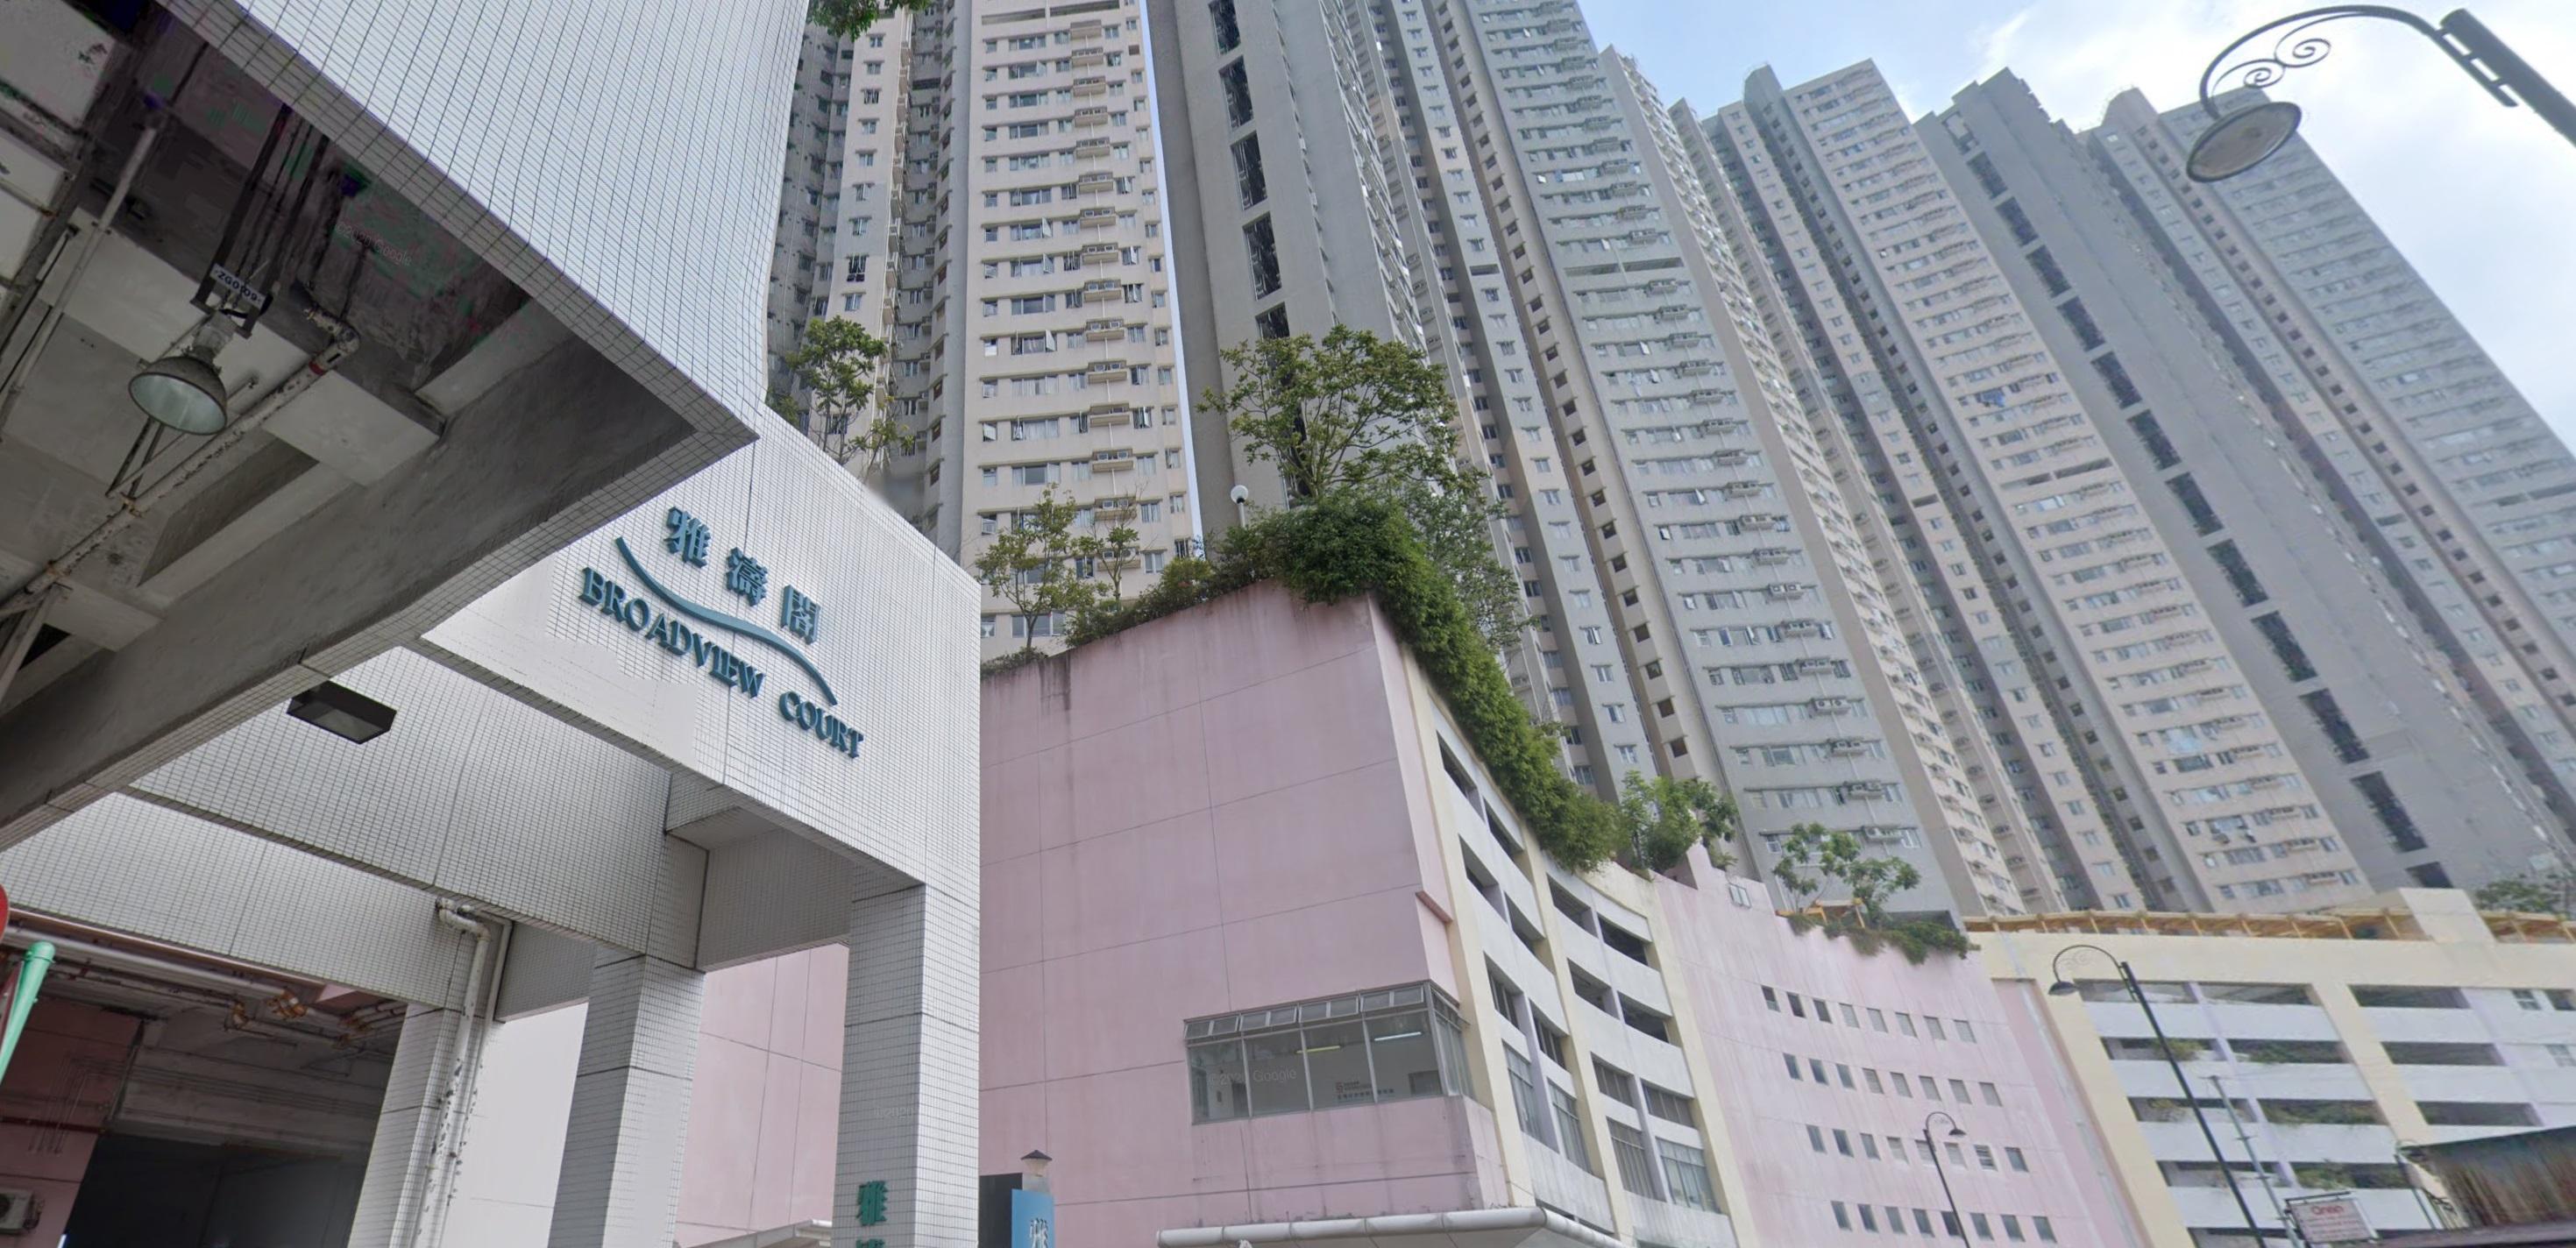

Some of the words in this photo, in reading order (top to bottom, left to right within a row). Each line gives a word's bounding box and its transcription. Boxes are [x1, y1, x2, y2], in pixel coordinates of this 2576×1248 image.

[664, 506, 821, 645] 雅濤閣
[578, 566, 766, 699] BROADVIEW
[778, 691, 864, 758] COURT
[856, 1180, 889, 1248] 雅
